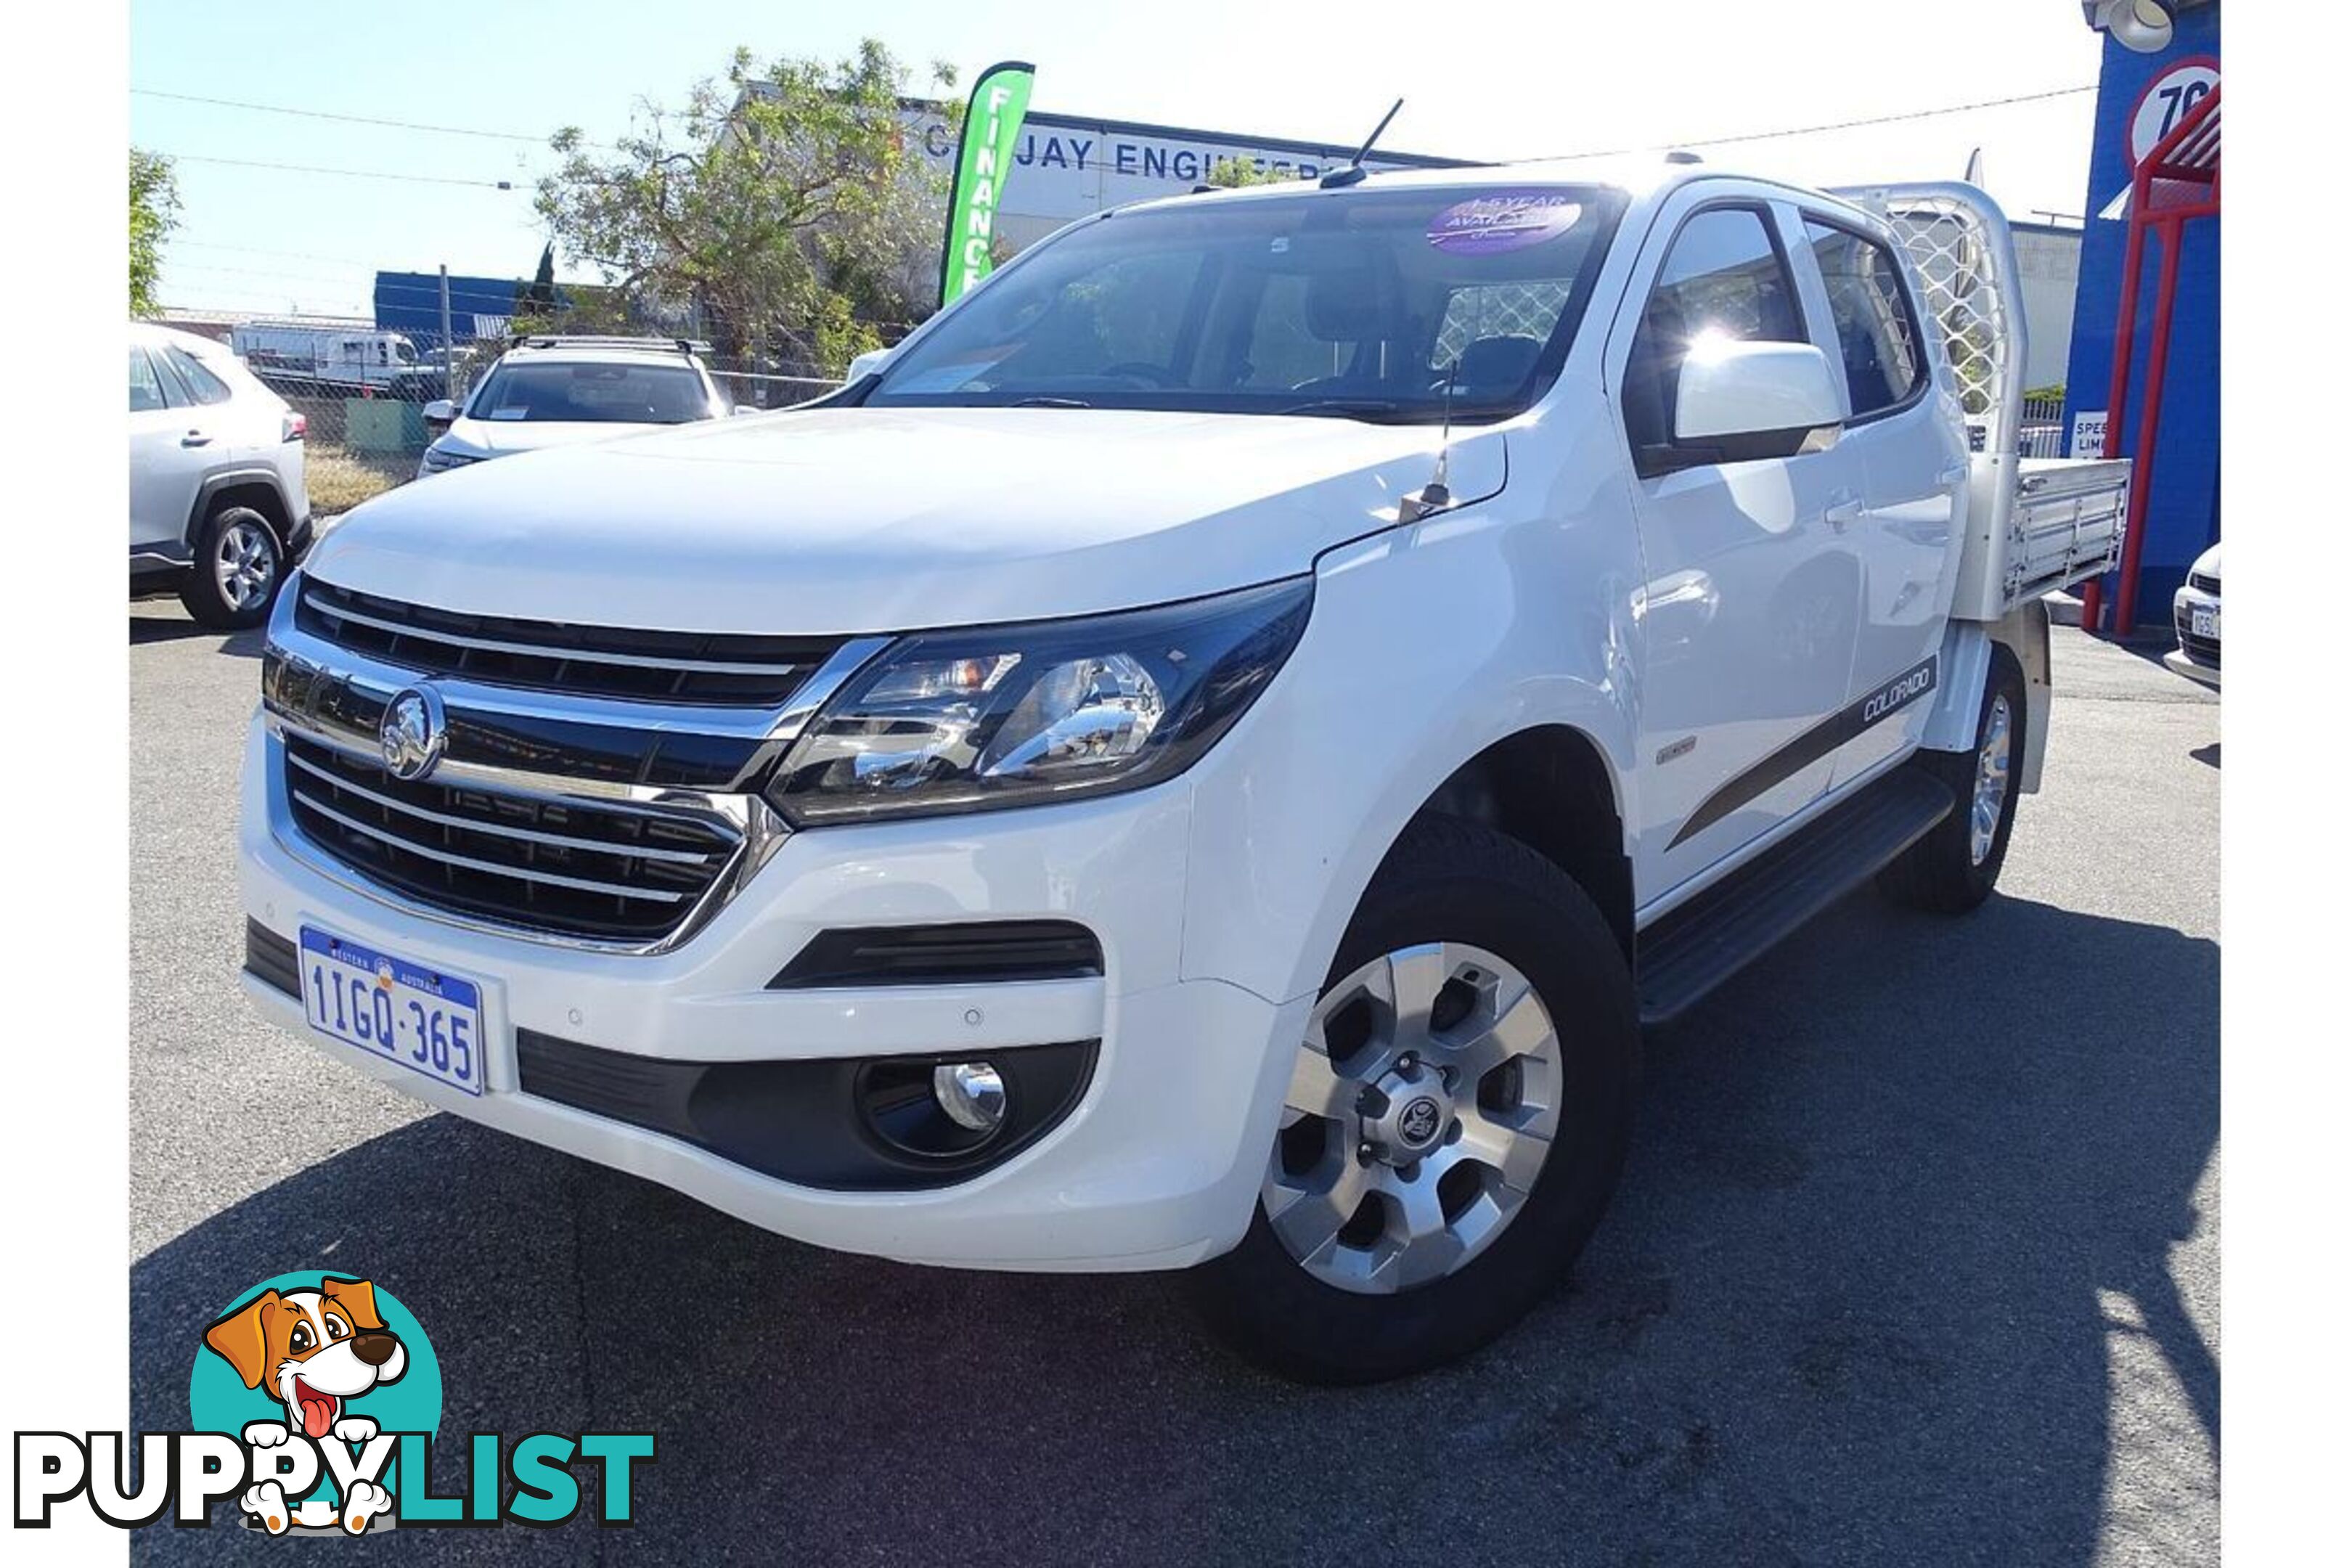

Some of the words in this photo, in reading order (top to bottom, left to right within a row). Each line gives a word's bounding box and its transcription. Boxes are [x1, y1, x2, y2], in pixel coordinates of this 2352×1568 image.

[963, 86, 1011, 293] FINANCE
[1863, 668, 1930, 722] COLORADO
[331, 948, 369, 969] WESTERN
[401, 973, 444, 995] AUSTRALIA
